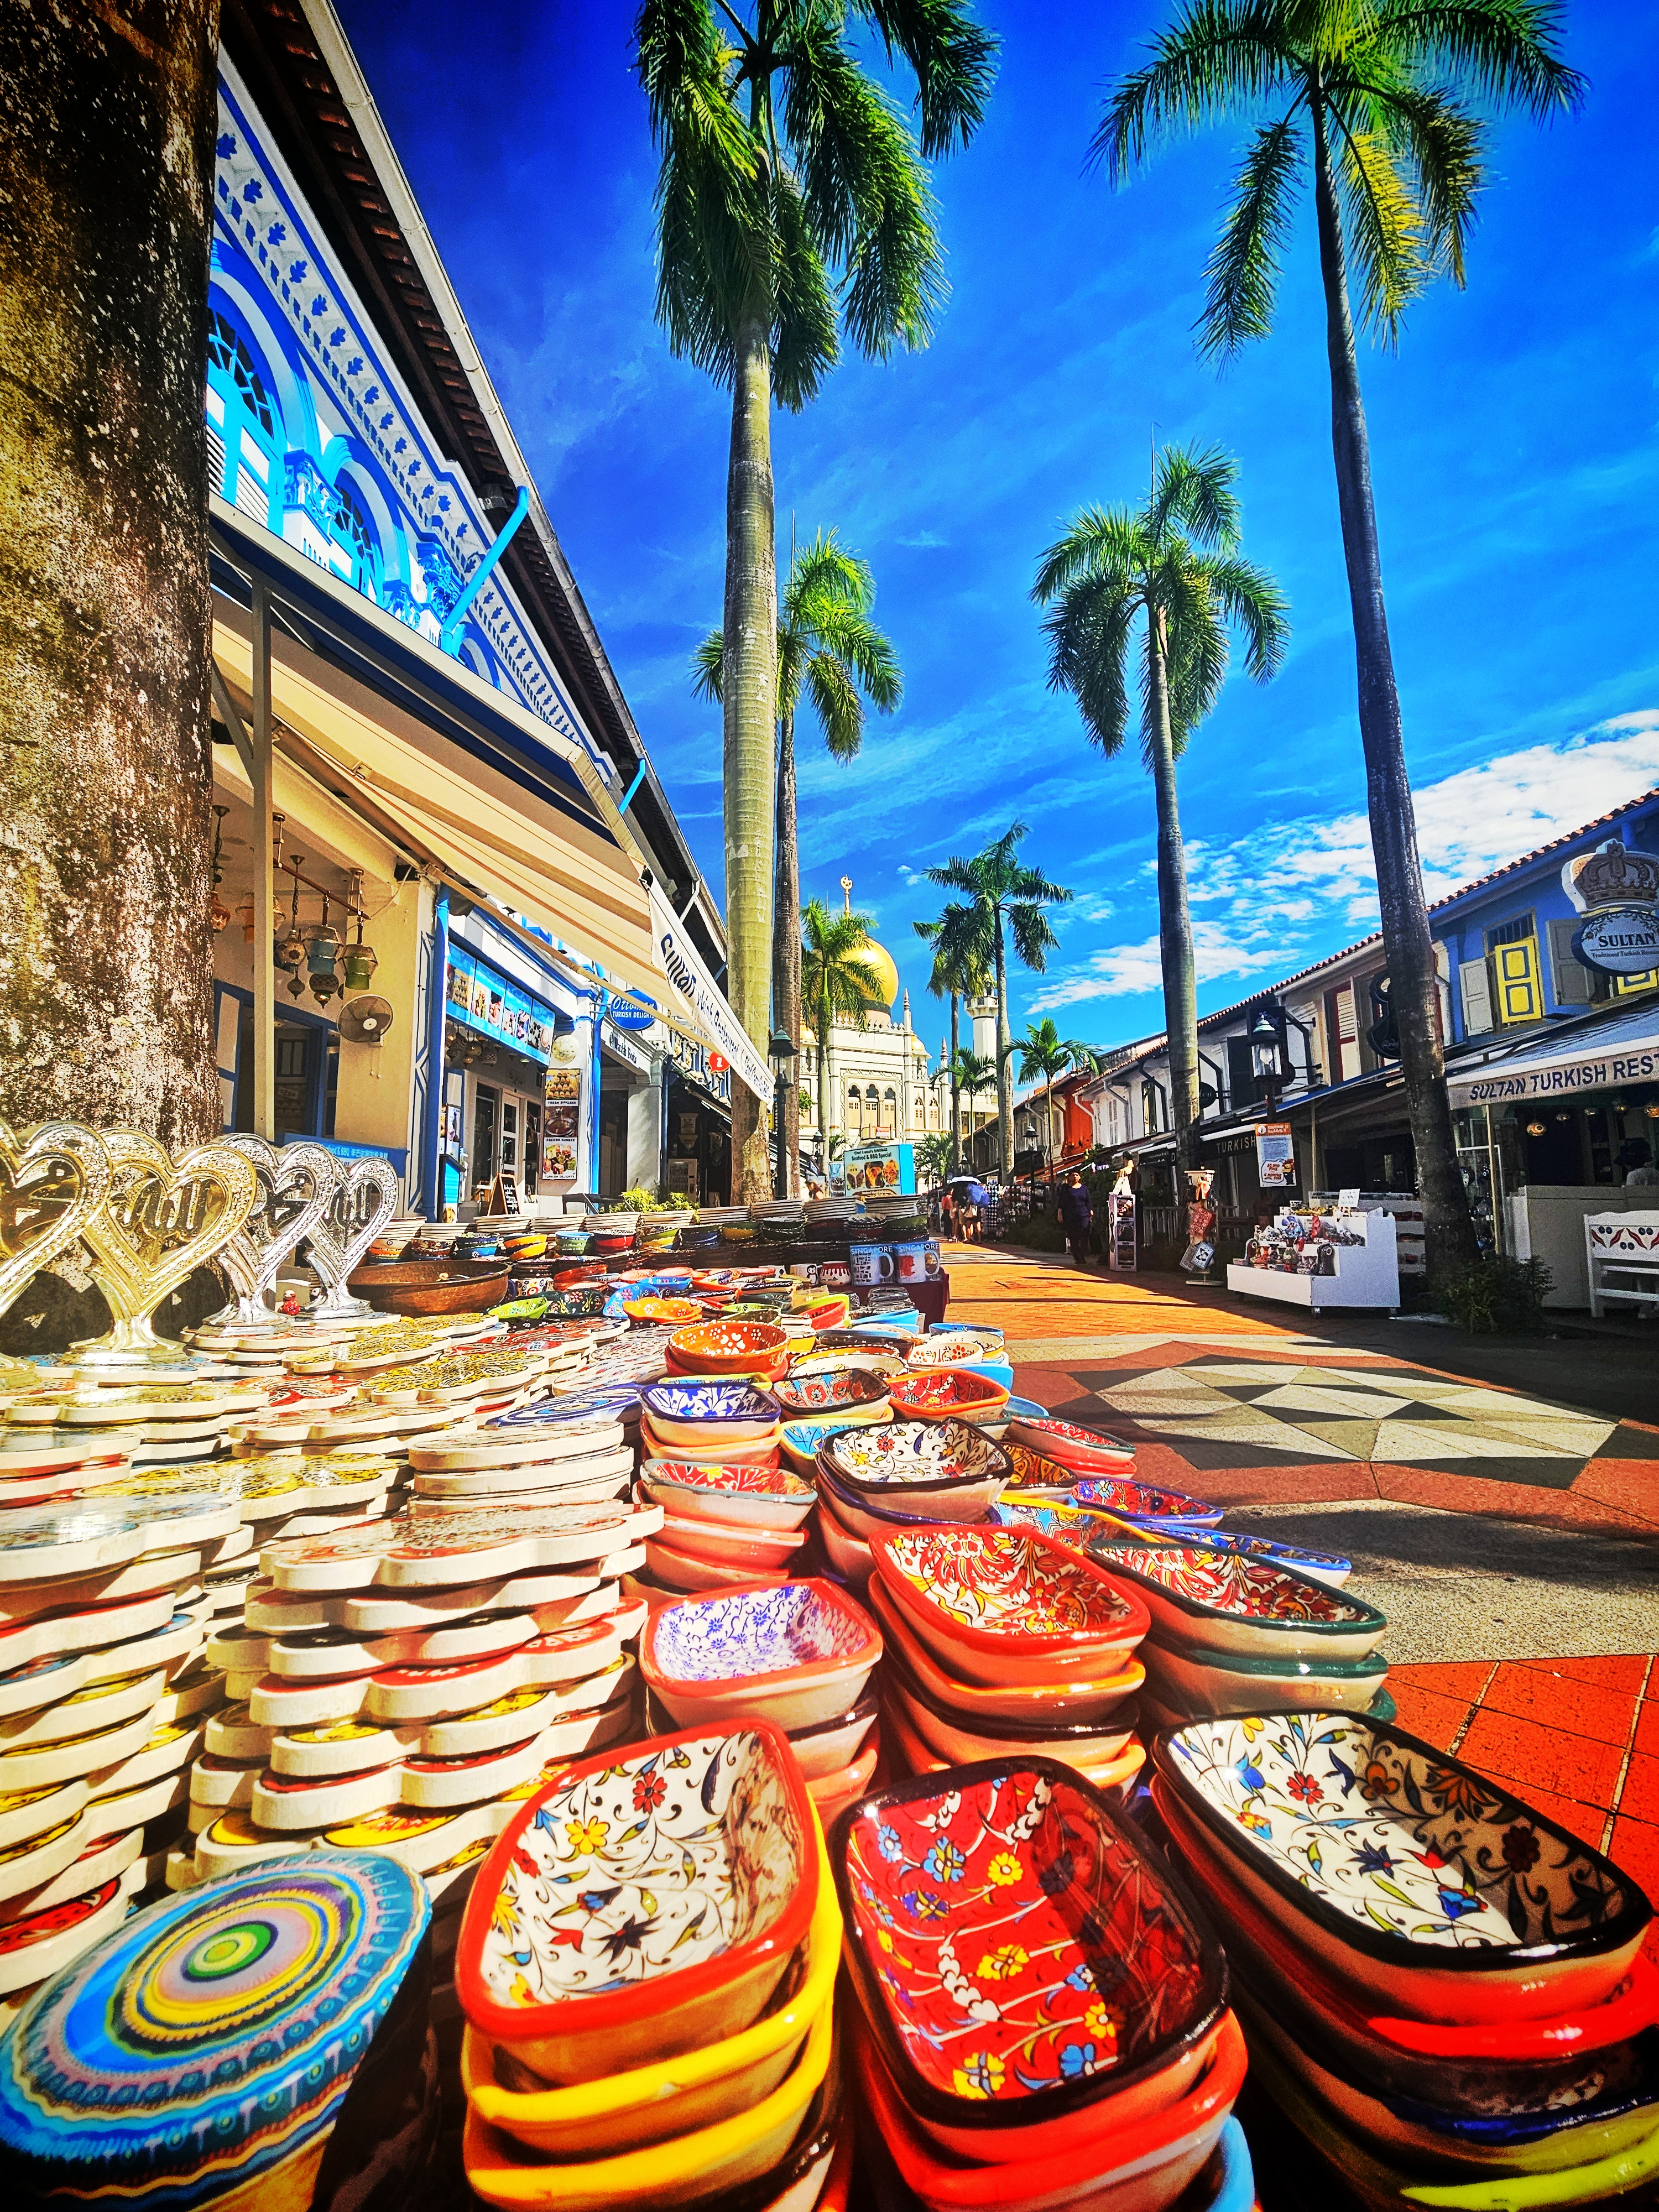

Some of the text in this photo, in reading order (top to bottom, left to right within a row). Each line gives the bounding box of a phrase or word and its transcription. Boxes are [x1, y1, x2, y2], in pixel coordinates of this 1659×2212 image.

[1598, 932, 1656, 947] SULTAN
[1469, 1077, 1526, 1100] SULTAN
[1530, 1063, 1606, 1092] TURKISH
[1217, 1135, 1256, 1154] TURKISH
[851, 1245, 893, 1255] SINGAPORE
[899, 1242, 940, 1253] SINGAPORE
